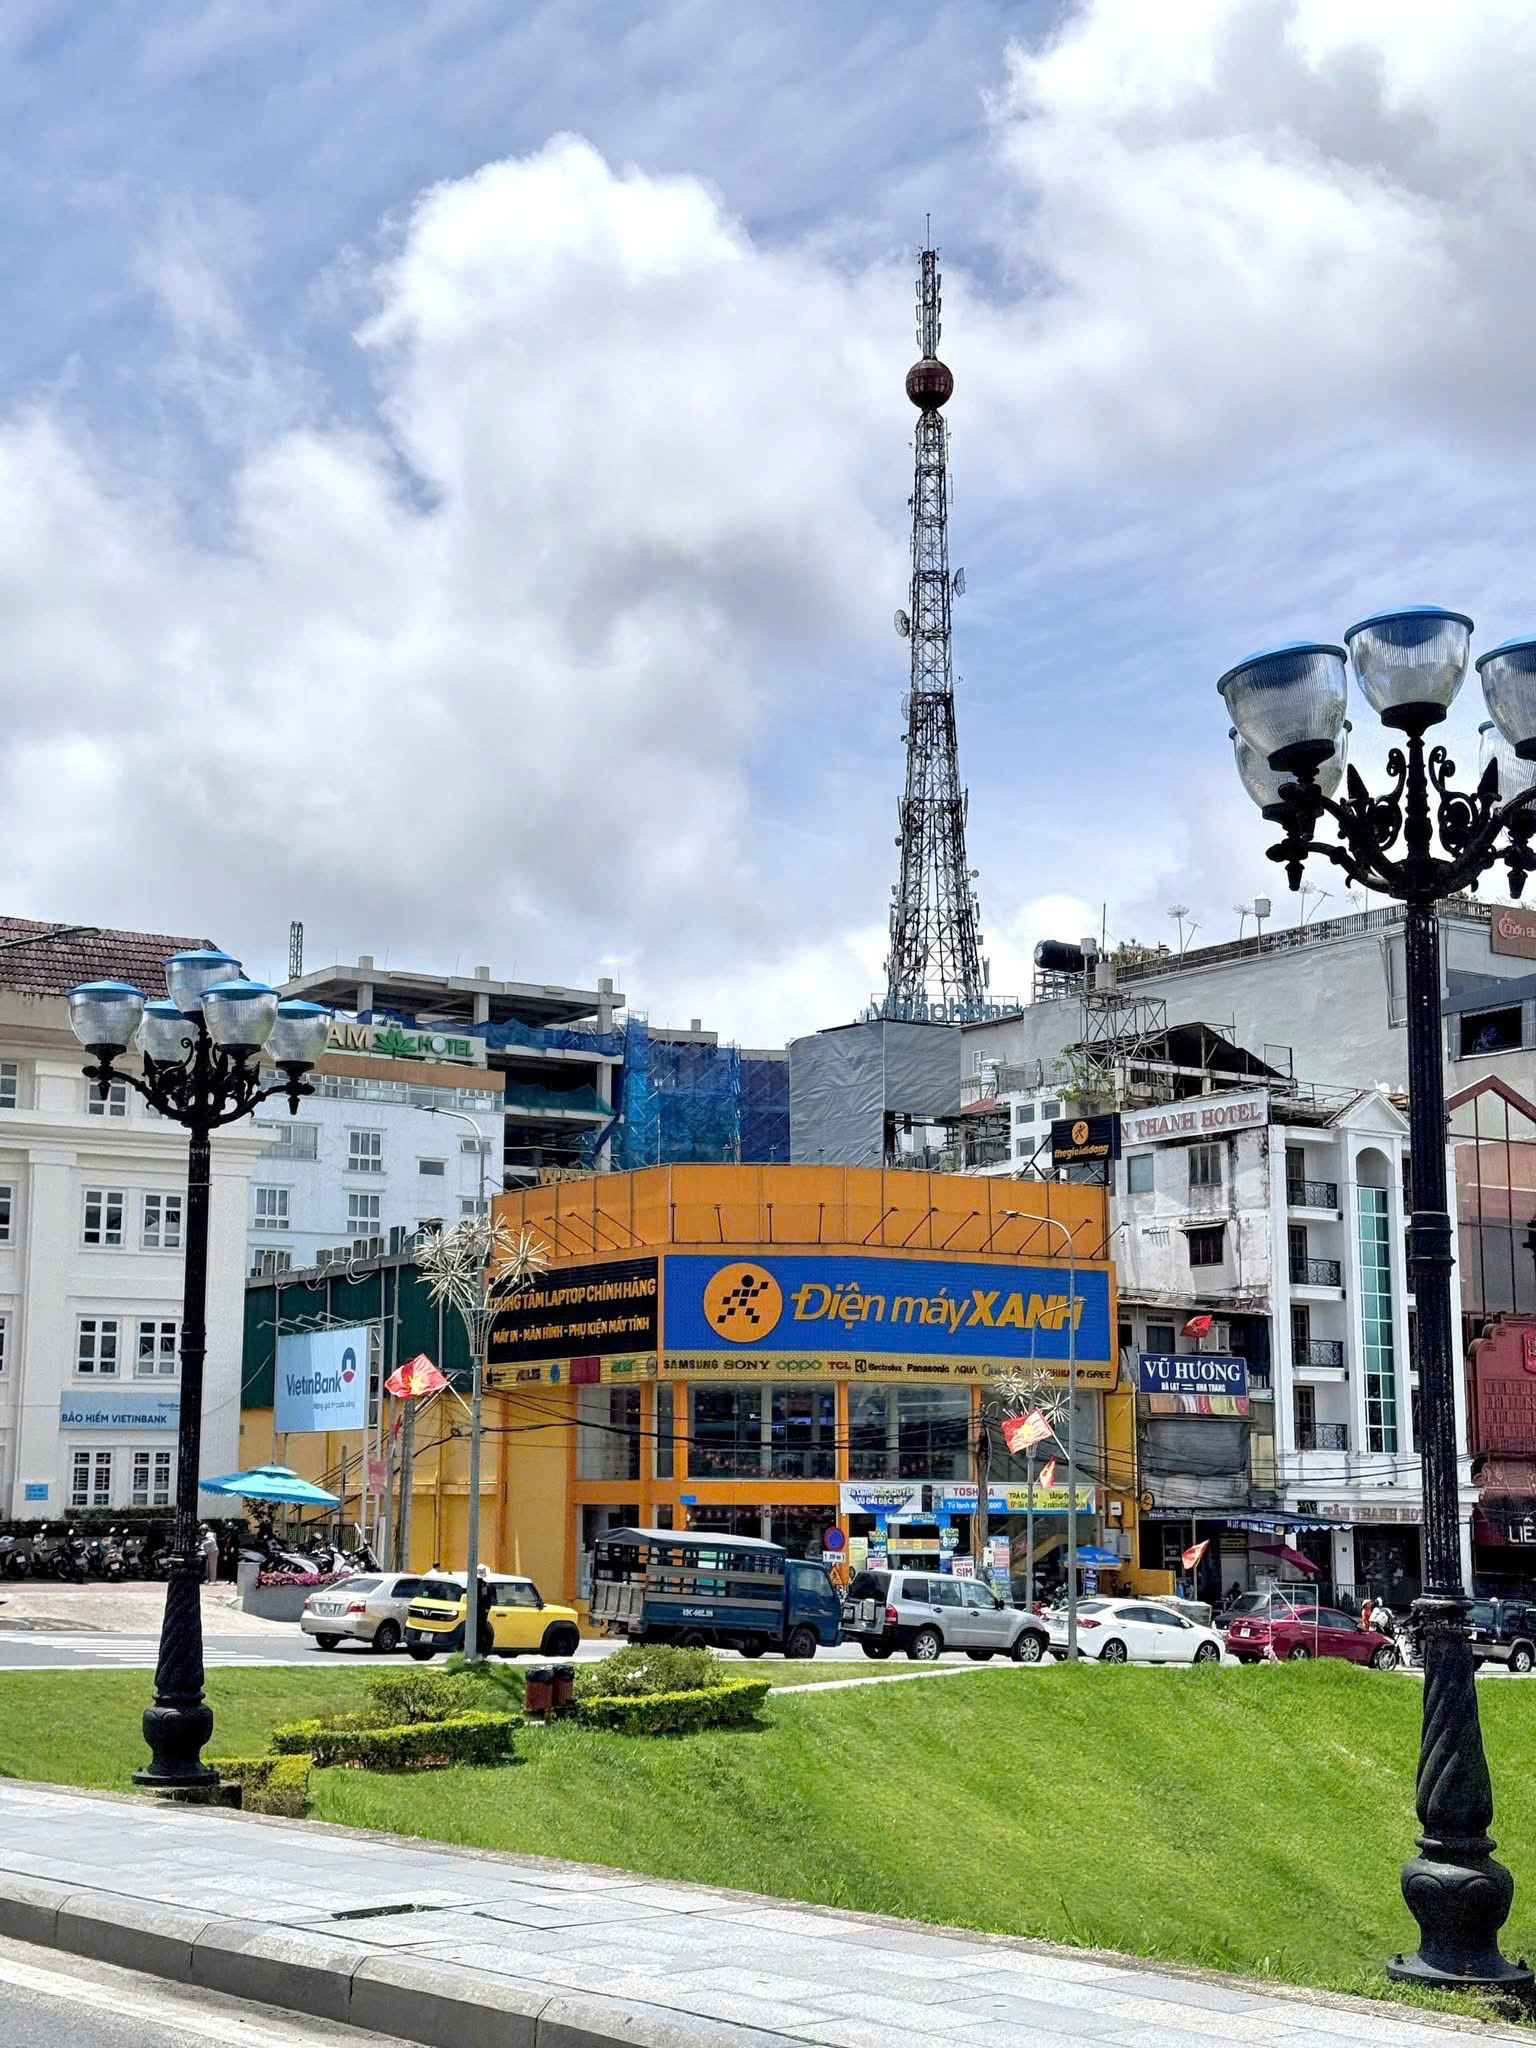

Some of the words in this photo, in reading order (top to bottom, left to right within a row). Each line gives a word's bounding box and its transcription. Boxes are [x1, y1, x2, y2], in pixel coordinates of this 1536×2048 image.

[417, 1034, 474, 1058] HOTEL
[1136, 1111, 1198, 1138] THANH
[1200, 1102, 1262, 1128] HOTEL
[522, 1288, 545, 1310] TÂM
[546, 1286, 586, 1308] LAPTOP
[586, 1279, 622, 1302] CHÍNH
[791, 1281, 885, 1329] Điện
[890, 1287, 970, 1334] máy
[964, 1290, 1084, 1330] XANH
[493, 1327, 510, 1345] MÁY
[510, 1330, 518, 1343] IN
[542, 1323, 564, 1340] HÌNH
[568, 1322, 587, 1340] PHỤ
[587, 1317, 608, 1340] KIỆN
[608, 1315, 628, 1334] MÁY
[628, 1314, 650, 1332] TÍNH
[663, 1359, 719, 1370] SAMSUNG
[723, 1359, 770, 1370] SONY
[827, 1361, 851, 1370] TCL
[868, 1362, 903, 1372] Electrolux
[906, 1363, 950, 1373] Panasonic
[954, 1365, 978, 1375] AQUA
[1086, 1370, 1111, 1379] GREE
[1144, 1357, 1170, 1379] VŨ
[1174, 1360, 1241, 1382] HƯƠNG
[286, 1370, 342, 1397] VietinBank
[1208, 1383, 1226, 1393] TRANG
[61, 1410, 83, 1423] BẢO
[86, 1411, 109, 1424] HIỂM
[111, 1414, 167, 1424] VIETINBANK
[953, 1487, 995, 1497] TOSHA
[956, 1567, 973, 1577] SIM
